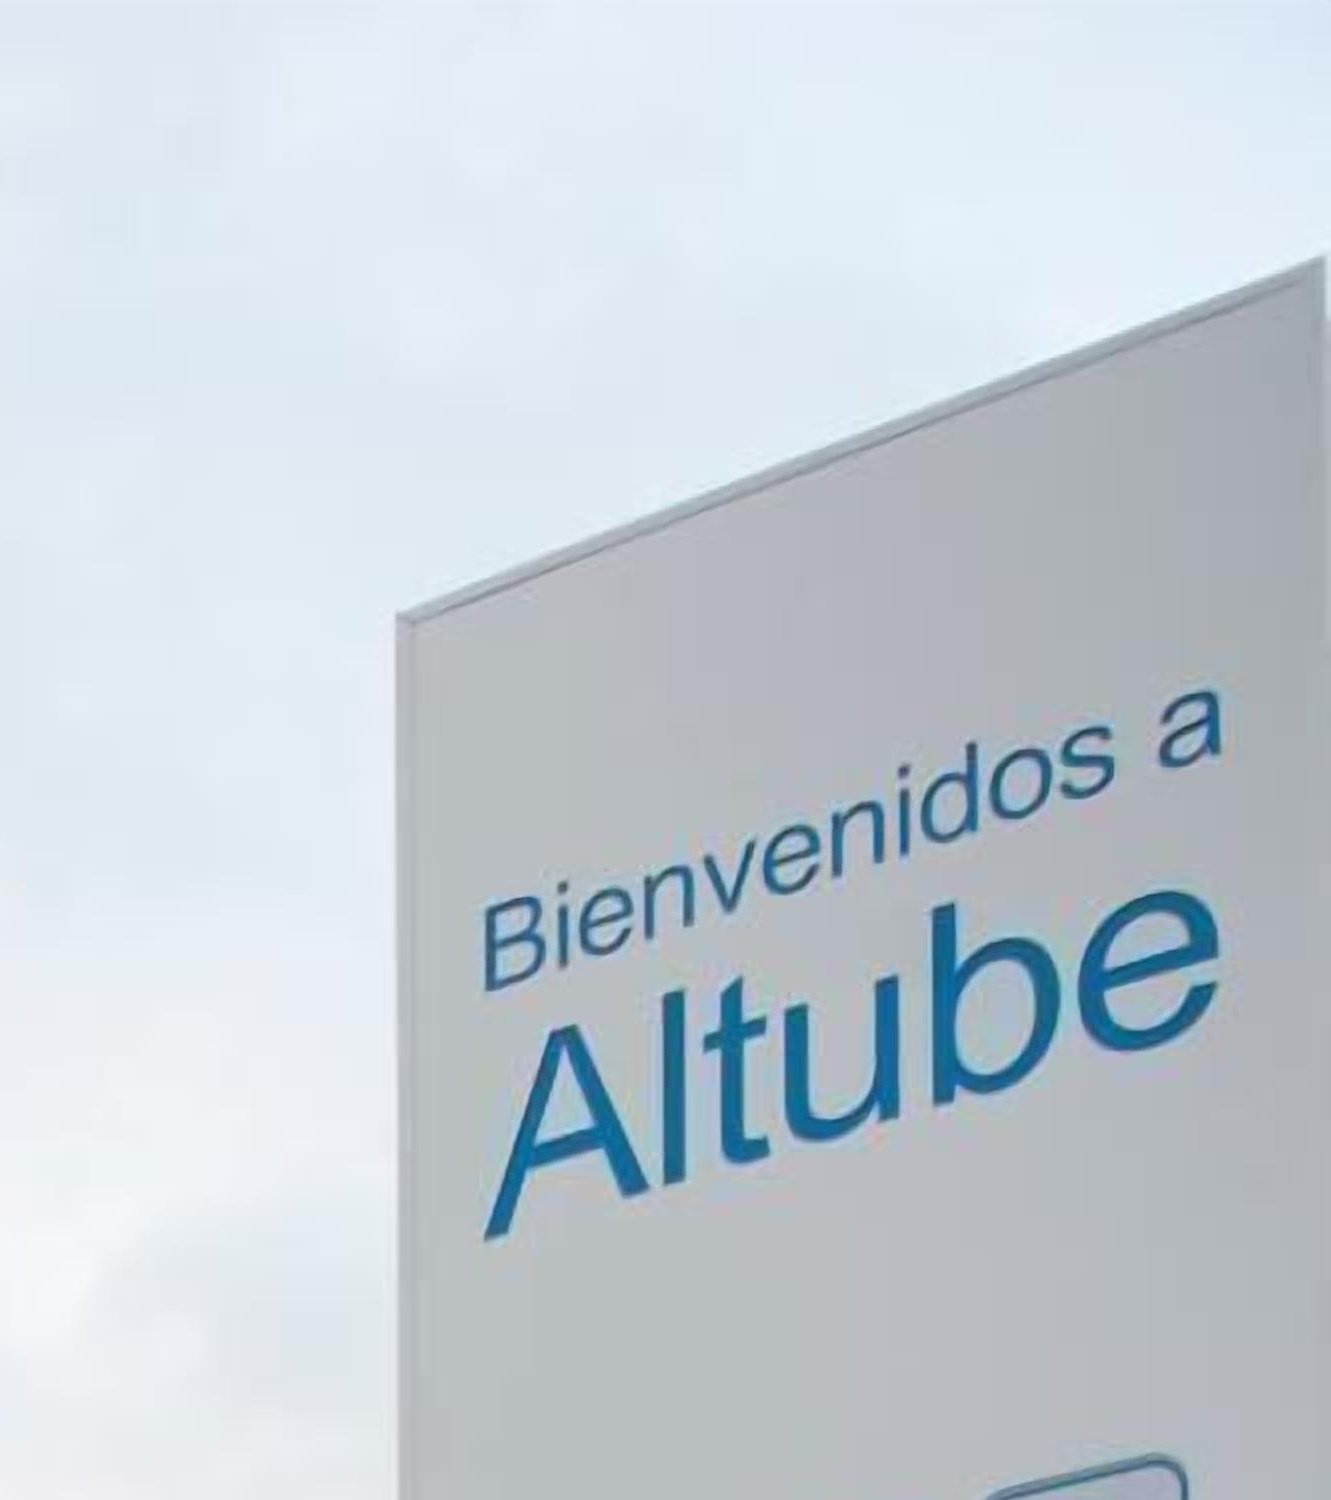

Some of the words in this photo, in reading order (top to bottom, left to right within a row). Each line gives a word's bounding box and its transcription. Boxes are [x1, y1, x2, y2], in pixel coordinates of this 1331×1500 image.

[484, 741, 1116, 992] Bienvenidos
[1158, 689, 1222, 769] a
[483, 888, 1219, 1243] Altube
